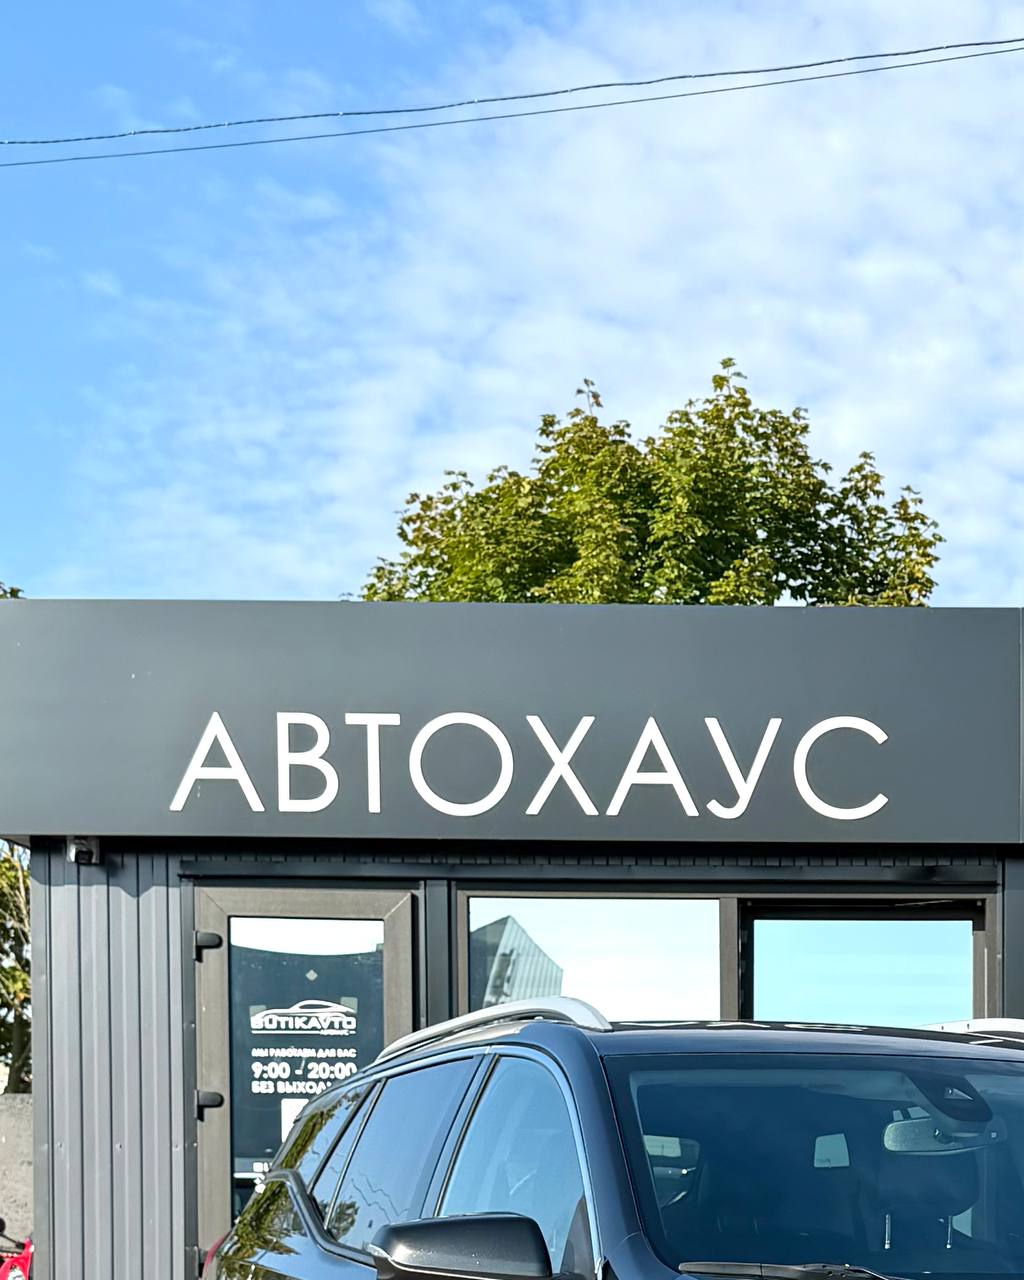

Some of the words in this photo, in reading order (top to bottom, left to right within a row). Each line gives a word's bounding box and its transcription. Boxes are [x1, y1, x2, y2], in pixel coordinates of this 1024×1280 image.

[169, 710, 890, 821] АВТОХАУС
[250, 1016, 357, 1030] BUTIKAVTO
[251, 1061, 291, 1079] 9:00
[307, 1061, 358, 1080] 20:00
[251, 1080, 275, 1094] БЕЗ
